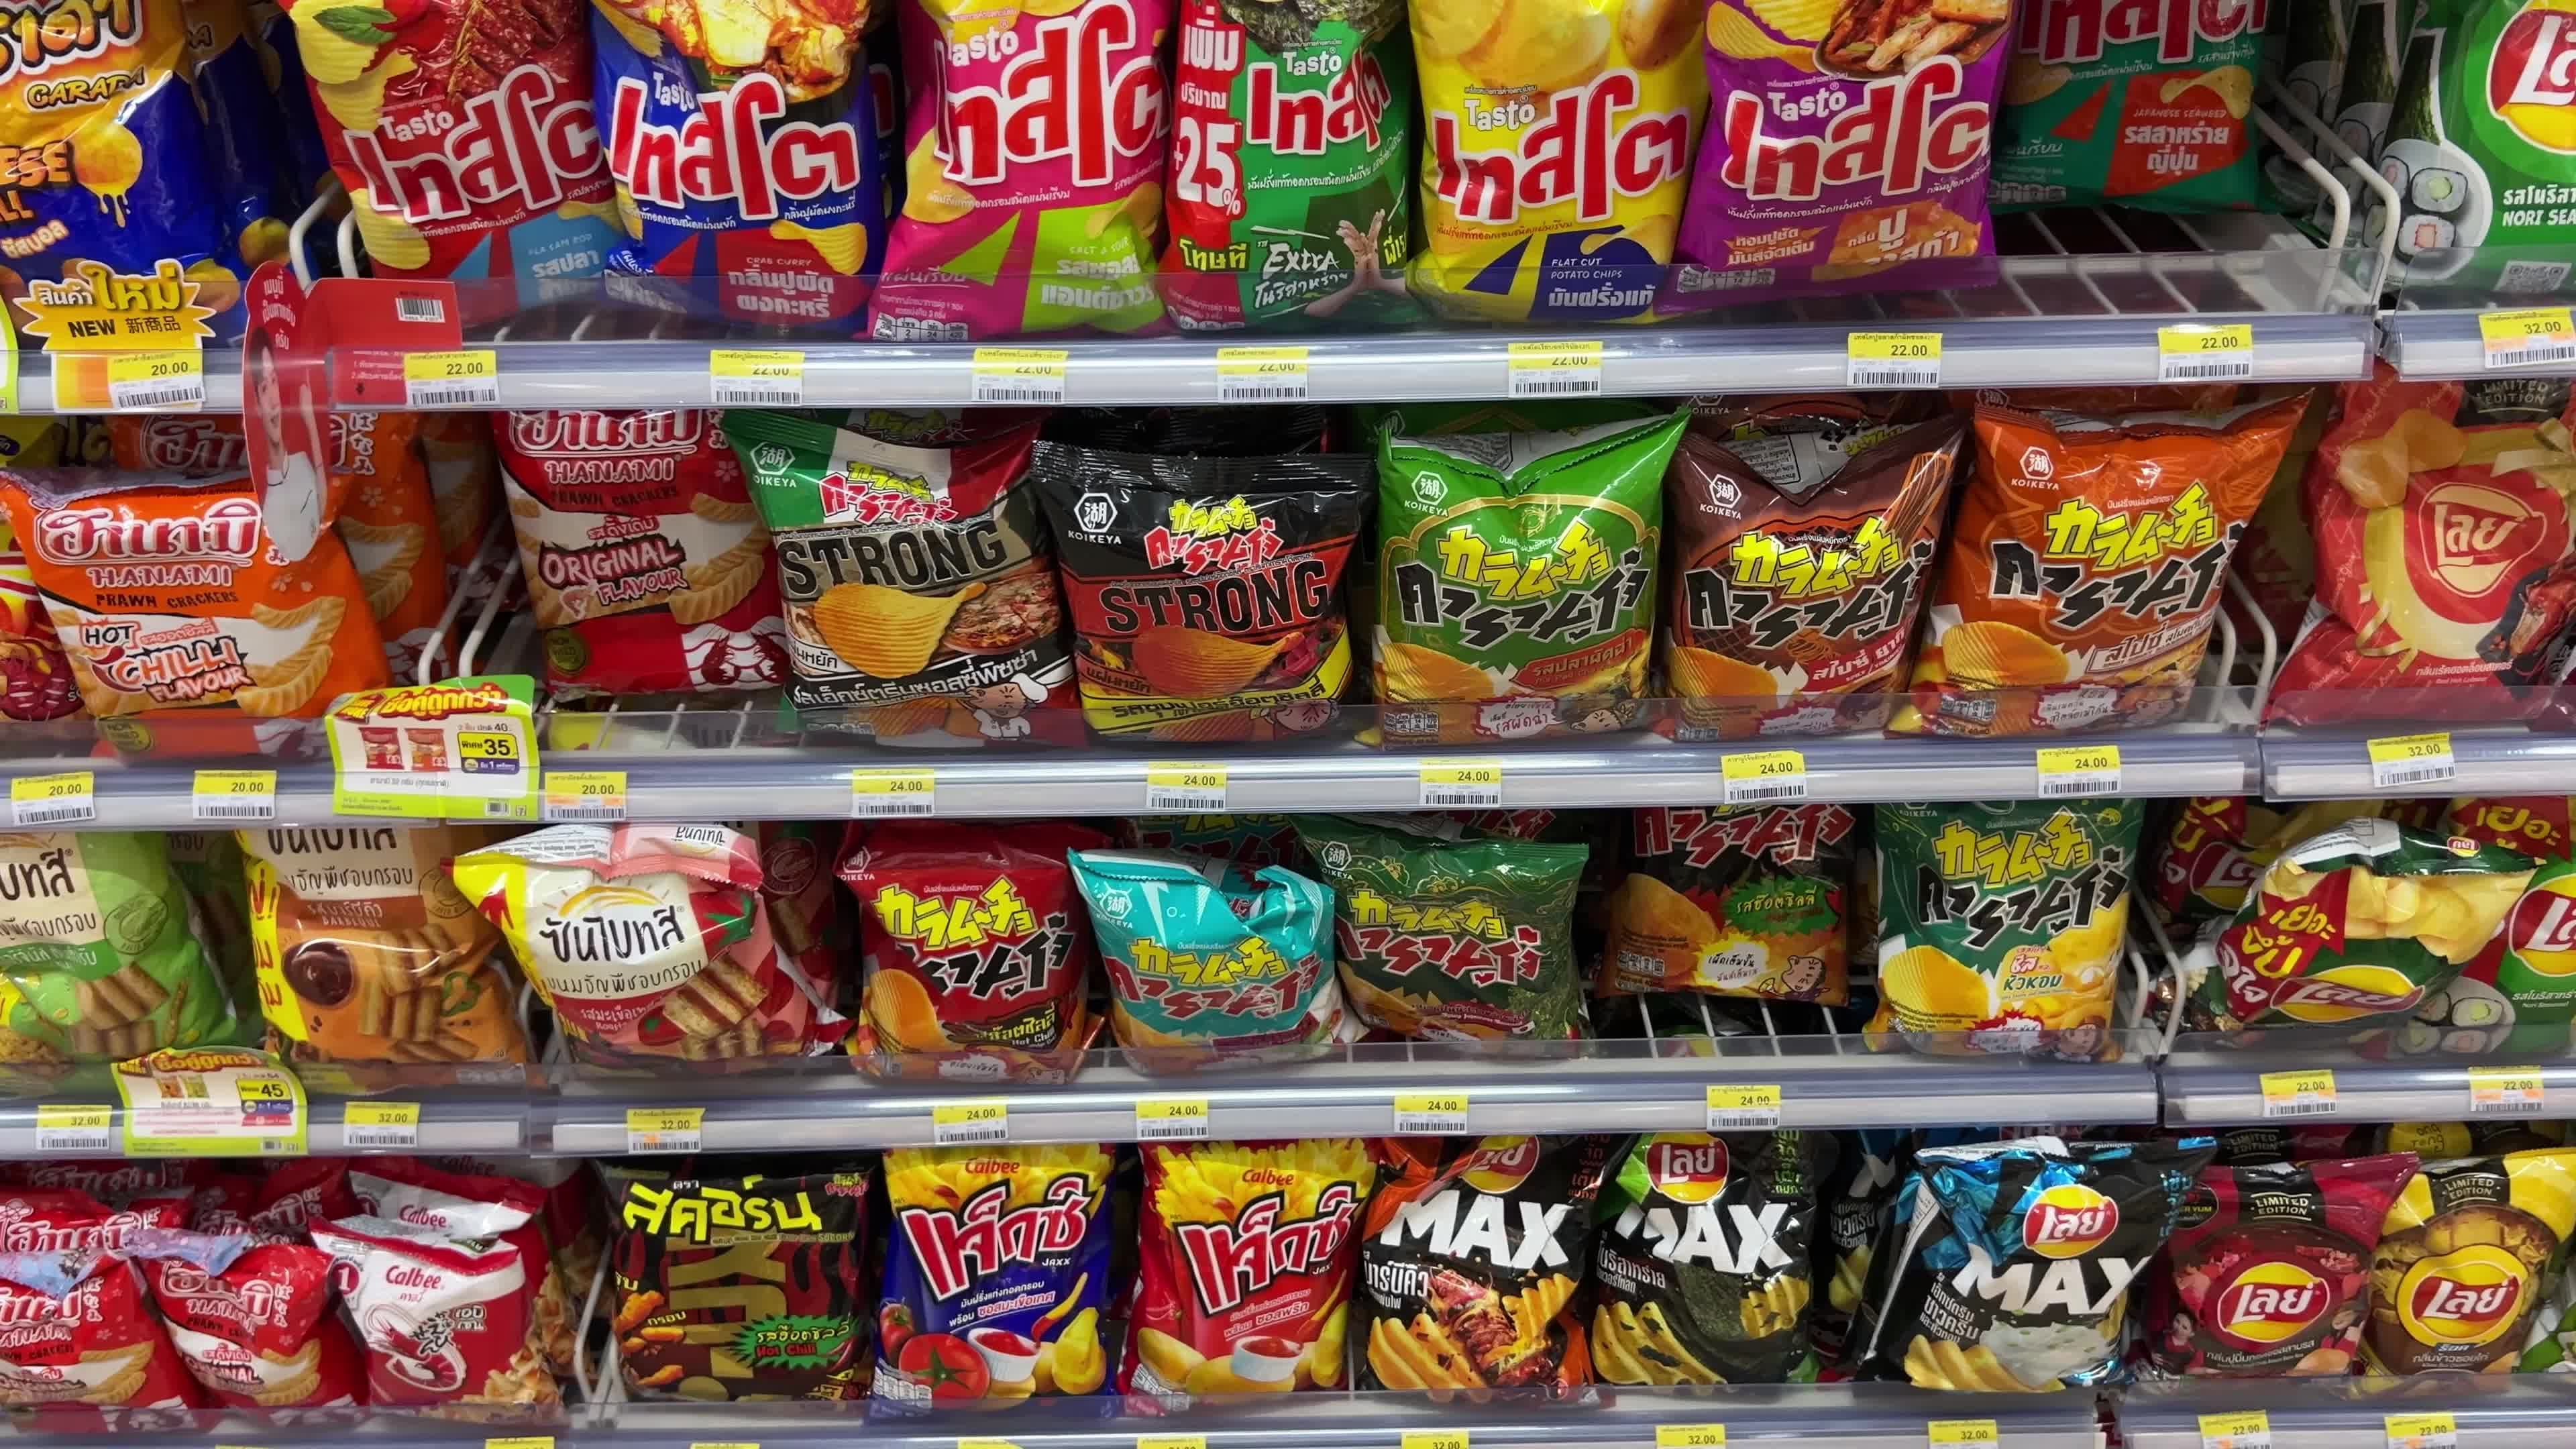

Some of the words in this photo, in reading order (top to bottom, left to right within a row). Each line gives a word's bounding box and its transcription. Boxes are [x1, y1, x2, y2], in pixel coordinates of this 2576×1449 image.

[1183, 7, 1240, 71] เพิ่ม
[1283, 50, 1342, 76] Tasto
[653, 72, 695, 111] Tasto
[1181, 82, 1226, 109] ปริมาณ
[1767, 89, 1847, 121] Tasto
[377, 107, 454, 141] Tasto
[1464, 99, 1535, 131] Tasto
[2125, 121, 2229, 144] รสสาหร่าย
[1432, 68, 1691, 225] เทสโต
[2147, 145, 2198, 173] ญี่ปุ่น
[2503, 211, 2542, 226] NORI
[1879, 209, 1907, 250] ปู
[1552, 258, 1578, 267] FLAT
[1581, 258, 1603, 266] CUT
[1551, 271, 1589, 279] POTATO
[1593, 270, 1622, 278] CHIPS
[37, 280, 93, 306] สินค้า
[80, 258, 183, 311] ใหม่
[1549, 282, 1656, 307] มันฝรั่งแท้
[68, 317, 117, 338] NEW
[125, 315, 181, 333] 新商品
[2524, 321, 2563, 336] 32.00
[1890, 345, 1927, 356] 22.00
[2201, 336, 2239, 350] 22.00
[151, 362, 189, 376] 20.00
[446, 362, 483, 375] 22.00
[761, 448, 786, 465] 湖
[2027, 455, 2049, 474] 湖
[544, 459, 675, 484] HANAMI
[1420, 478, 1441, 498] 湖
[1715, 481, 1735, 502] 湖
[2010, 478, 2059, 490] KOIKEYA
[1085, 501, 1108, 531] 湖
[1168, 494, 1258, 537] カラムーチョ
[1404, 499, 1449, 517] KOIKEYA
[1699, 503, 1742, 520] KOIKEYA
[39, 498, 260, 562] ฮานามิ
[2044, 480, 2218, 570] カラムーチョ
[1067, 530, 1122, 545] KOIKEYA
[541, 539, 684, 585] ORIGINAL
[778, 519, 1009, 596] STRONG
[1438, 517, 1613, 600] カラムーチョ
[1729, 515, 1902, 598] カラムーチョ
[87, 565, 233, 587] HANAMI
[597, 569, 687, 605] FLAVOUR
[1098, 559, 1331, 633] STRONG
[96, 593, 156, 608] PRAWN
[166, 593, 237, 609] CRACKERS
[85, 624, 133, 647] HOT
[115, 639, 246, 683] CHILLI
[148, 666, 252, 700] FLAVOUR
[380, 689, 502, 715] ซื้อคู่ถูกกว่า
[494, 723, 508, 731] 40
[484, 739, 511, 755] 35
[2407, 744, 2440, 757] 32.00
[1760, 762, 1793, 774] 24.00
[2075, 757, 2108, 769] 24.00
[1183, 775, 1216, 786] 24.00
[1457, 770, 1490, 782] 24.00
[48, 783, 82, 796] 20.00
[231, 782, 264, 794] 20.00
[582, 784, 615, 795] 20.00
[890, 780, 922, 792] 24.00
[1328, 847, 1346, 865] 湖
[1933, 806, 2094, 890] カラムーチョ
[840, 873, 875, 881] OIKEYA
[874, 877, 1036, 948] カラムーチョ
[1107, 896, 1126, 912] 湖
[1347, 889, 1509, 940] カラムーチョ
[1130, 936, 1288, 986] カラムーチョ
[2003, 975, 2063, 991] หัวหอม
[261, 1084, 284, 1097] 45
[2296, 1081, 2325, 1092] 22.00
[2503, 1080, 2533, 1091] 22.00
[1428, 1101, 1457, 1111] 24.00
[1740, 1095, 1770, 1106] 24.00
[378, 1113, 408, 1123] 32.00
[966, 1108, 996, 1120] 24.00
[1169, 1105, 1199, 1116] 24.00
[70, 1116, 101, 1126] 32.00
[660, 1119, 691, 1130] 32.00
[965, 1157, 1021, 1175] Calbee
[1242, 1168, 1295, 1186] Calbee
[2444, 1178, 2495, 1191] LIMITED
[2255, 1195, 2309, 1208] LIMITED
[2449, 1187, 2493, 1200] EDITION
[399, 1204, 447, 1229] Calbee
[623, 1174, 822, 1241] สคอร์น
[2258, 1205, 2308, 1216] EDITION
[1380, 1189, 1575, 1269] MAX
[1614, 1202, 1794, 1274] MAX
[1042, 1257, 1071, 1267] JAXX
[337, 1267, 352, 1291] 1
[386, 1265, 442, 1289] Calbee
[1951, 1256, 2152, 1315] MAX
[961, 1280, 1044, 1308] มันฝรั่งแท่งทอดกรอบ
[2231, 1282, 2314, 1324] เลย์
[2422, 1278, 2509, 1320] เลย์
[647, 1310, 687, 1326] กรอบ
[949, 1312, 975, 1328] พร้อม
[977, 1291, 1056, 1318] ซอสมะเขือเทศ
[1224, 1320, 1252, 1338] พร้อม
[1255, 1300, 1310, 1325] ซอสพริก
[756, 1346, 780, 1358] Hot
[1960, 1430, 1988, 1440] 32.00
[2233, 1424, 2260, 1435] 22.00
[2419, 1425, 2447, 1436] 22.00
[1688, 1436, 1716, 1444] 32.00
